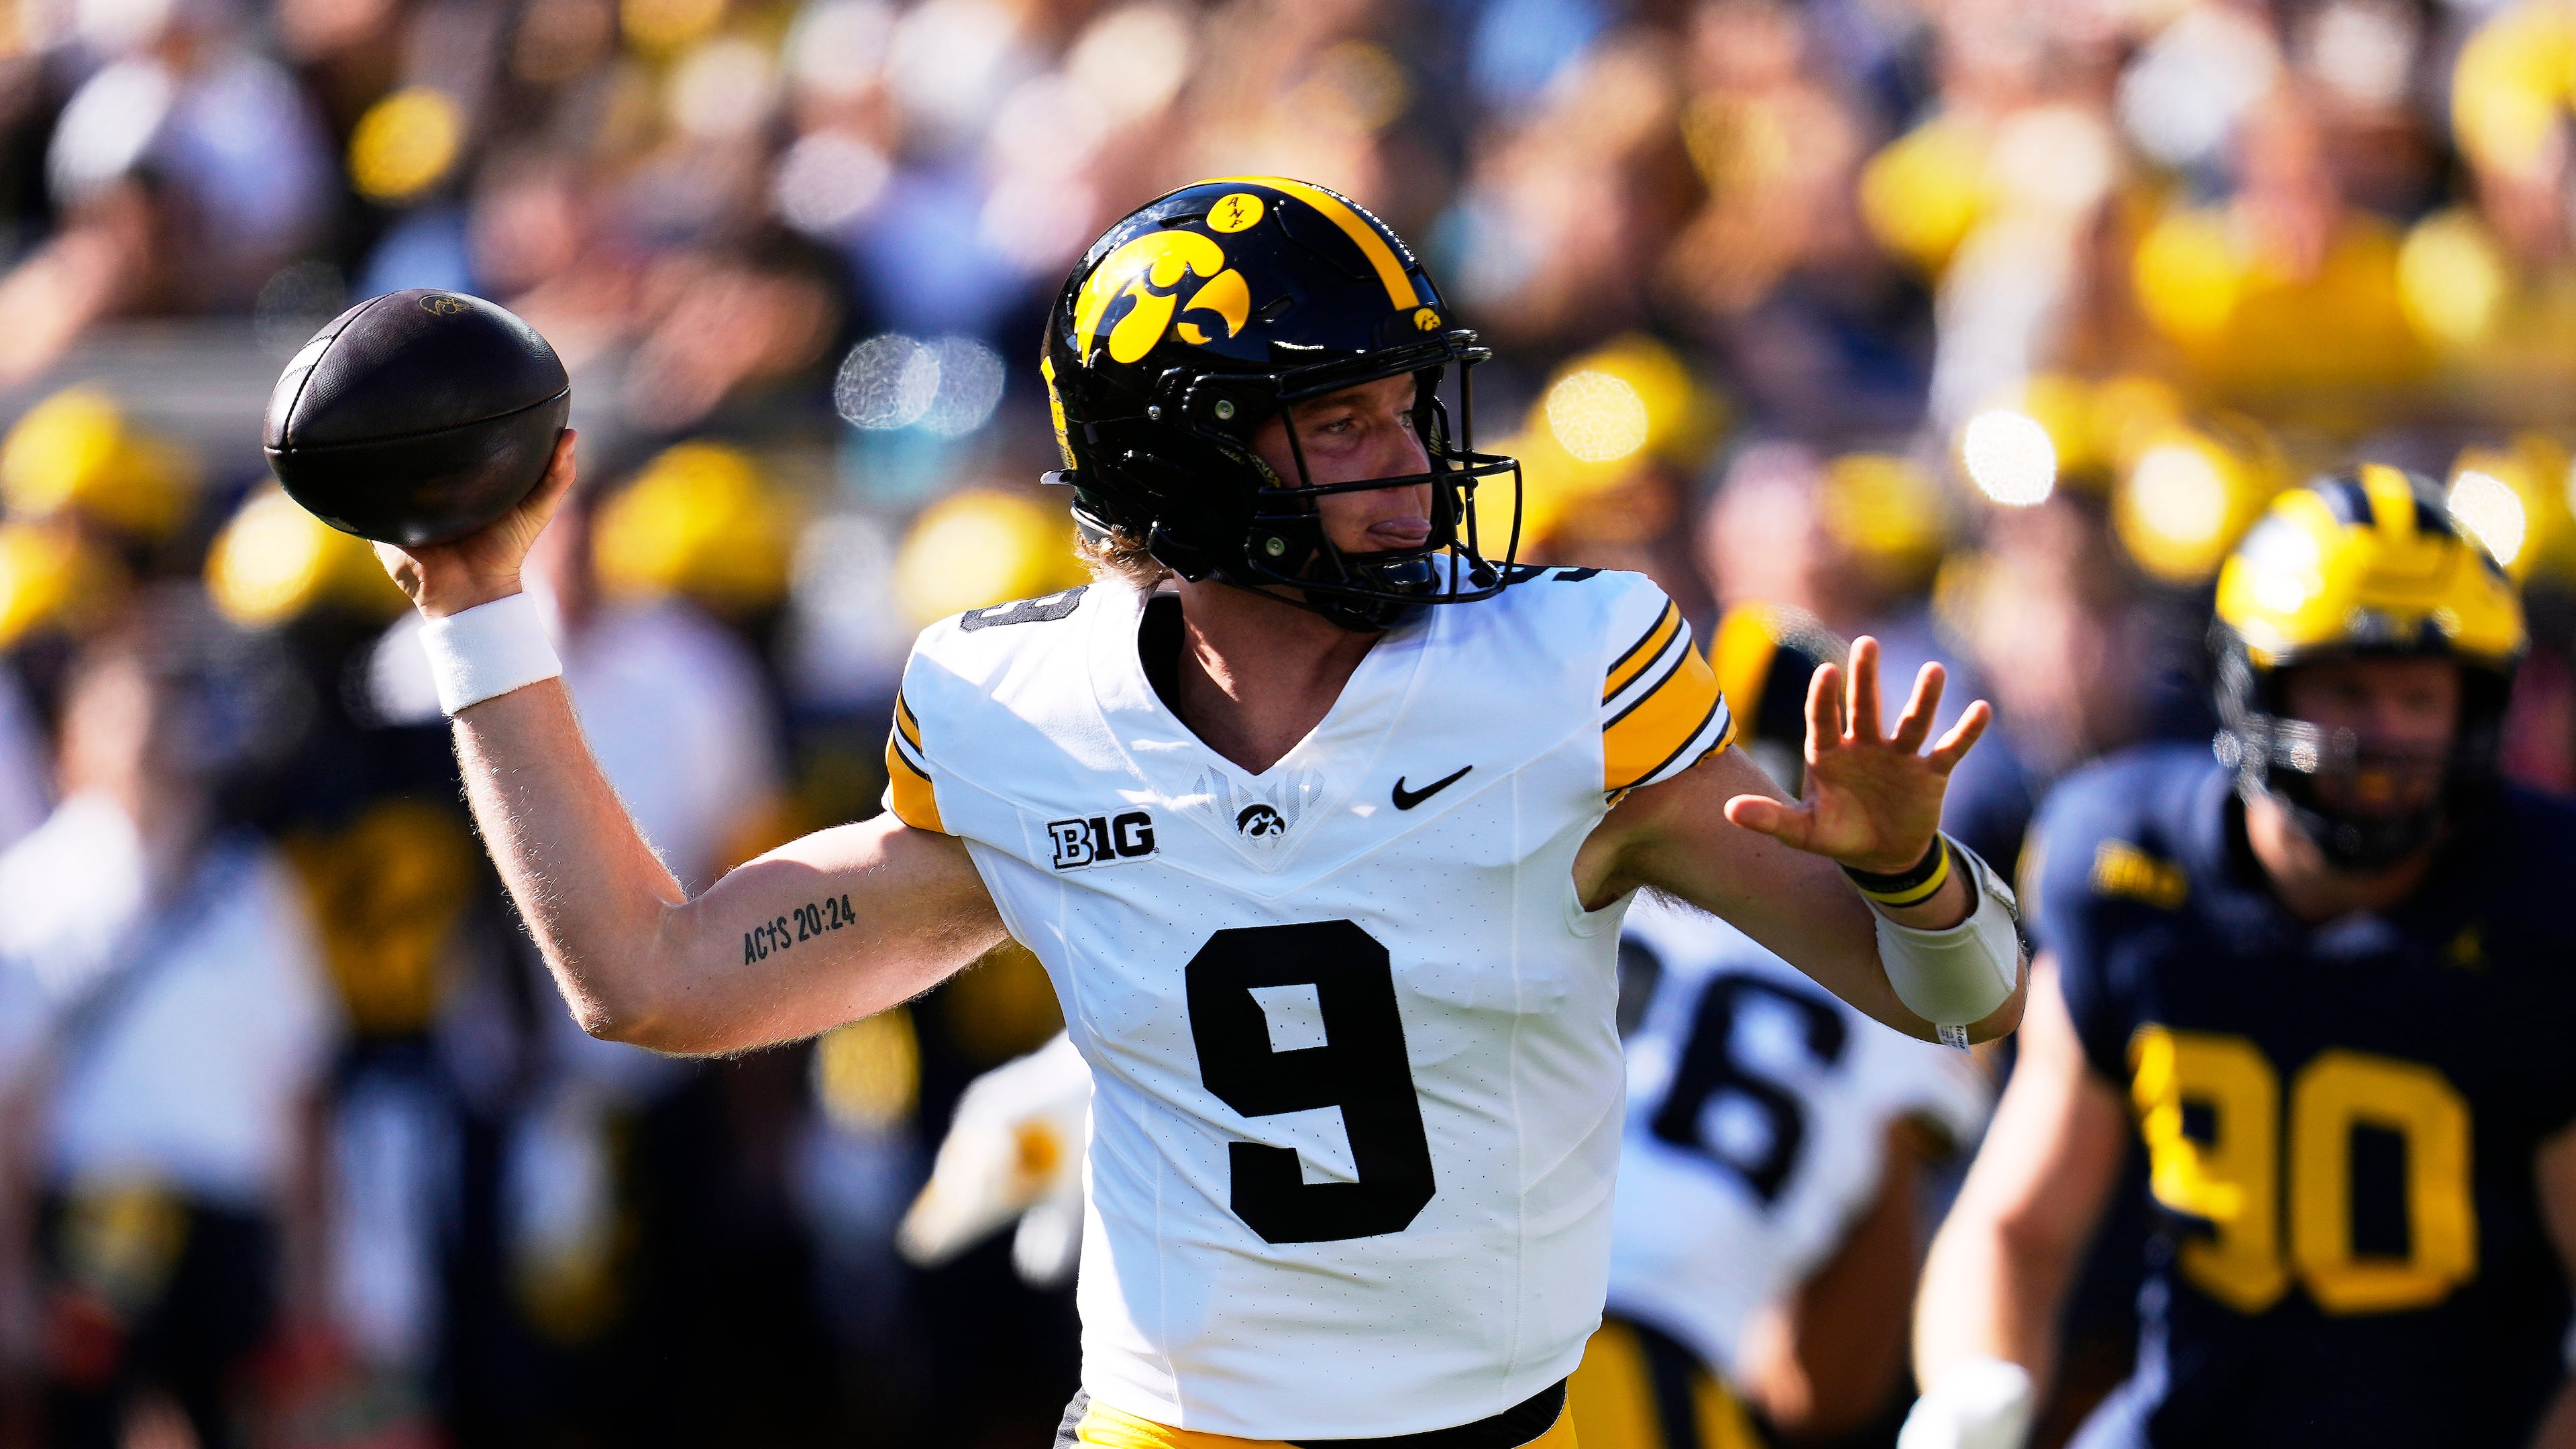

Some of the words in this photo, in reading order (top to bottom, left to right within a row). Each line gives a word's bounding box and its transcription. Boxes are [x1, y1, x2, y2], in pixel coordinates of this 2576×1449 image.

[794, 894, 855, 942] 20:24
[1185, 918, 1436, 1244] 9
[2125, 1022, 2477, 1317] 90
